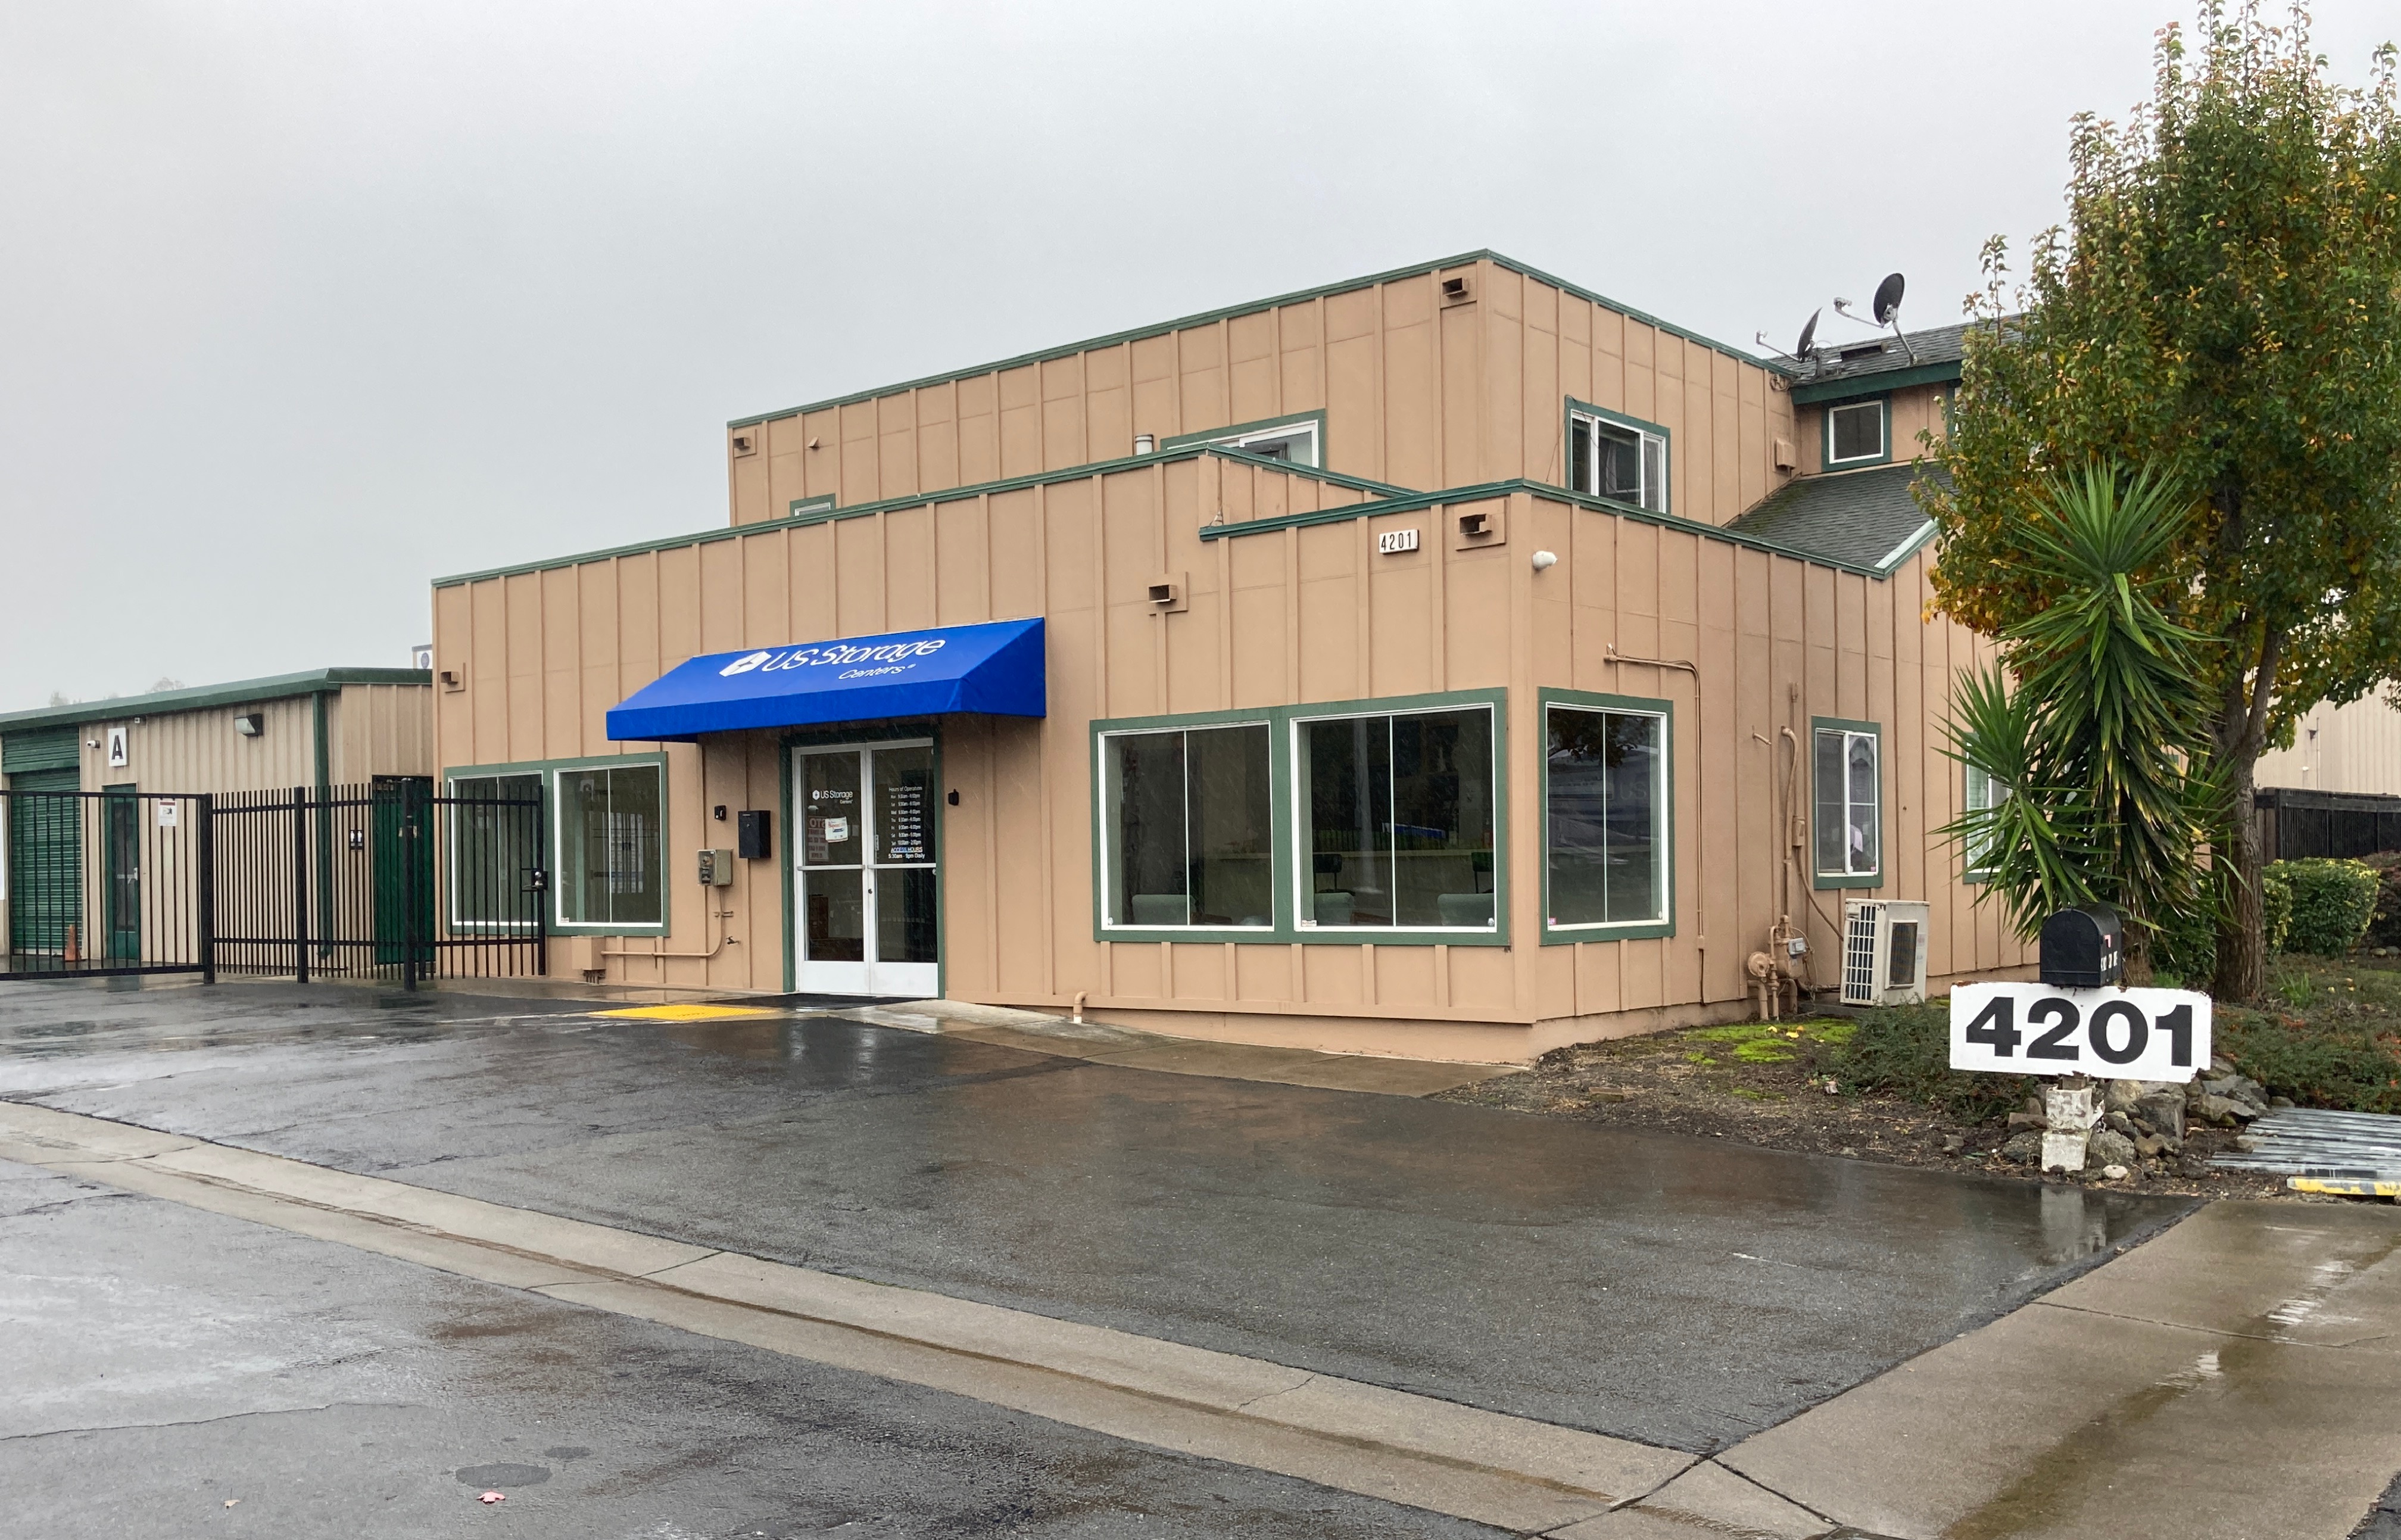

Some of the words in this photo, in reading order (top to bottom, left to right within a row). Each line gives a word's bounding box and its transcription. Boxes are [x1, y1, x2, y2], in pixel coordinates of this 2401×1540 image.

[1381, 532, 1411, 551] 4201
[761, 649, 819, 672] US
[810, 640, 946, 665] Storage
[111, 734, 123, 760] A
[821, 790, 829, 799] US
[830, 790, 853, 800] Storage
[1966, 996, 2192, 1067] 4201
